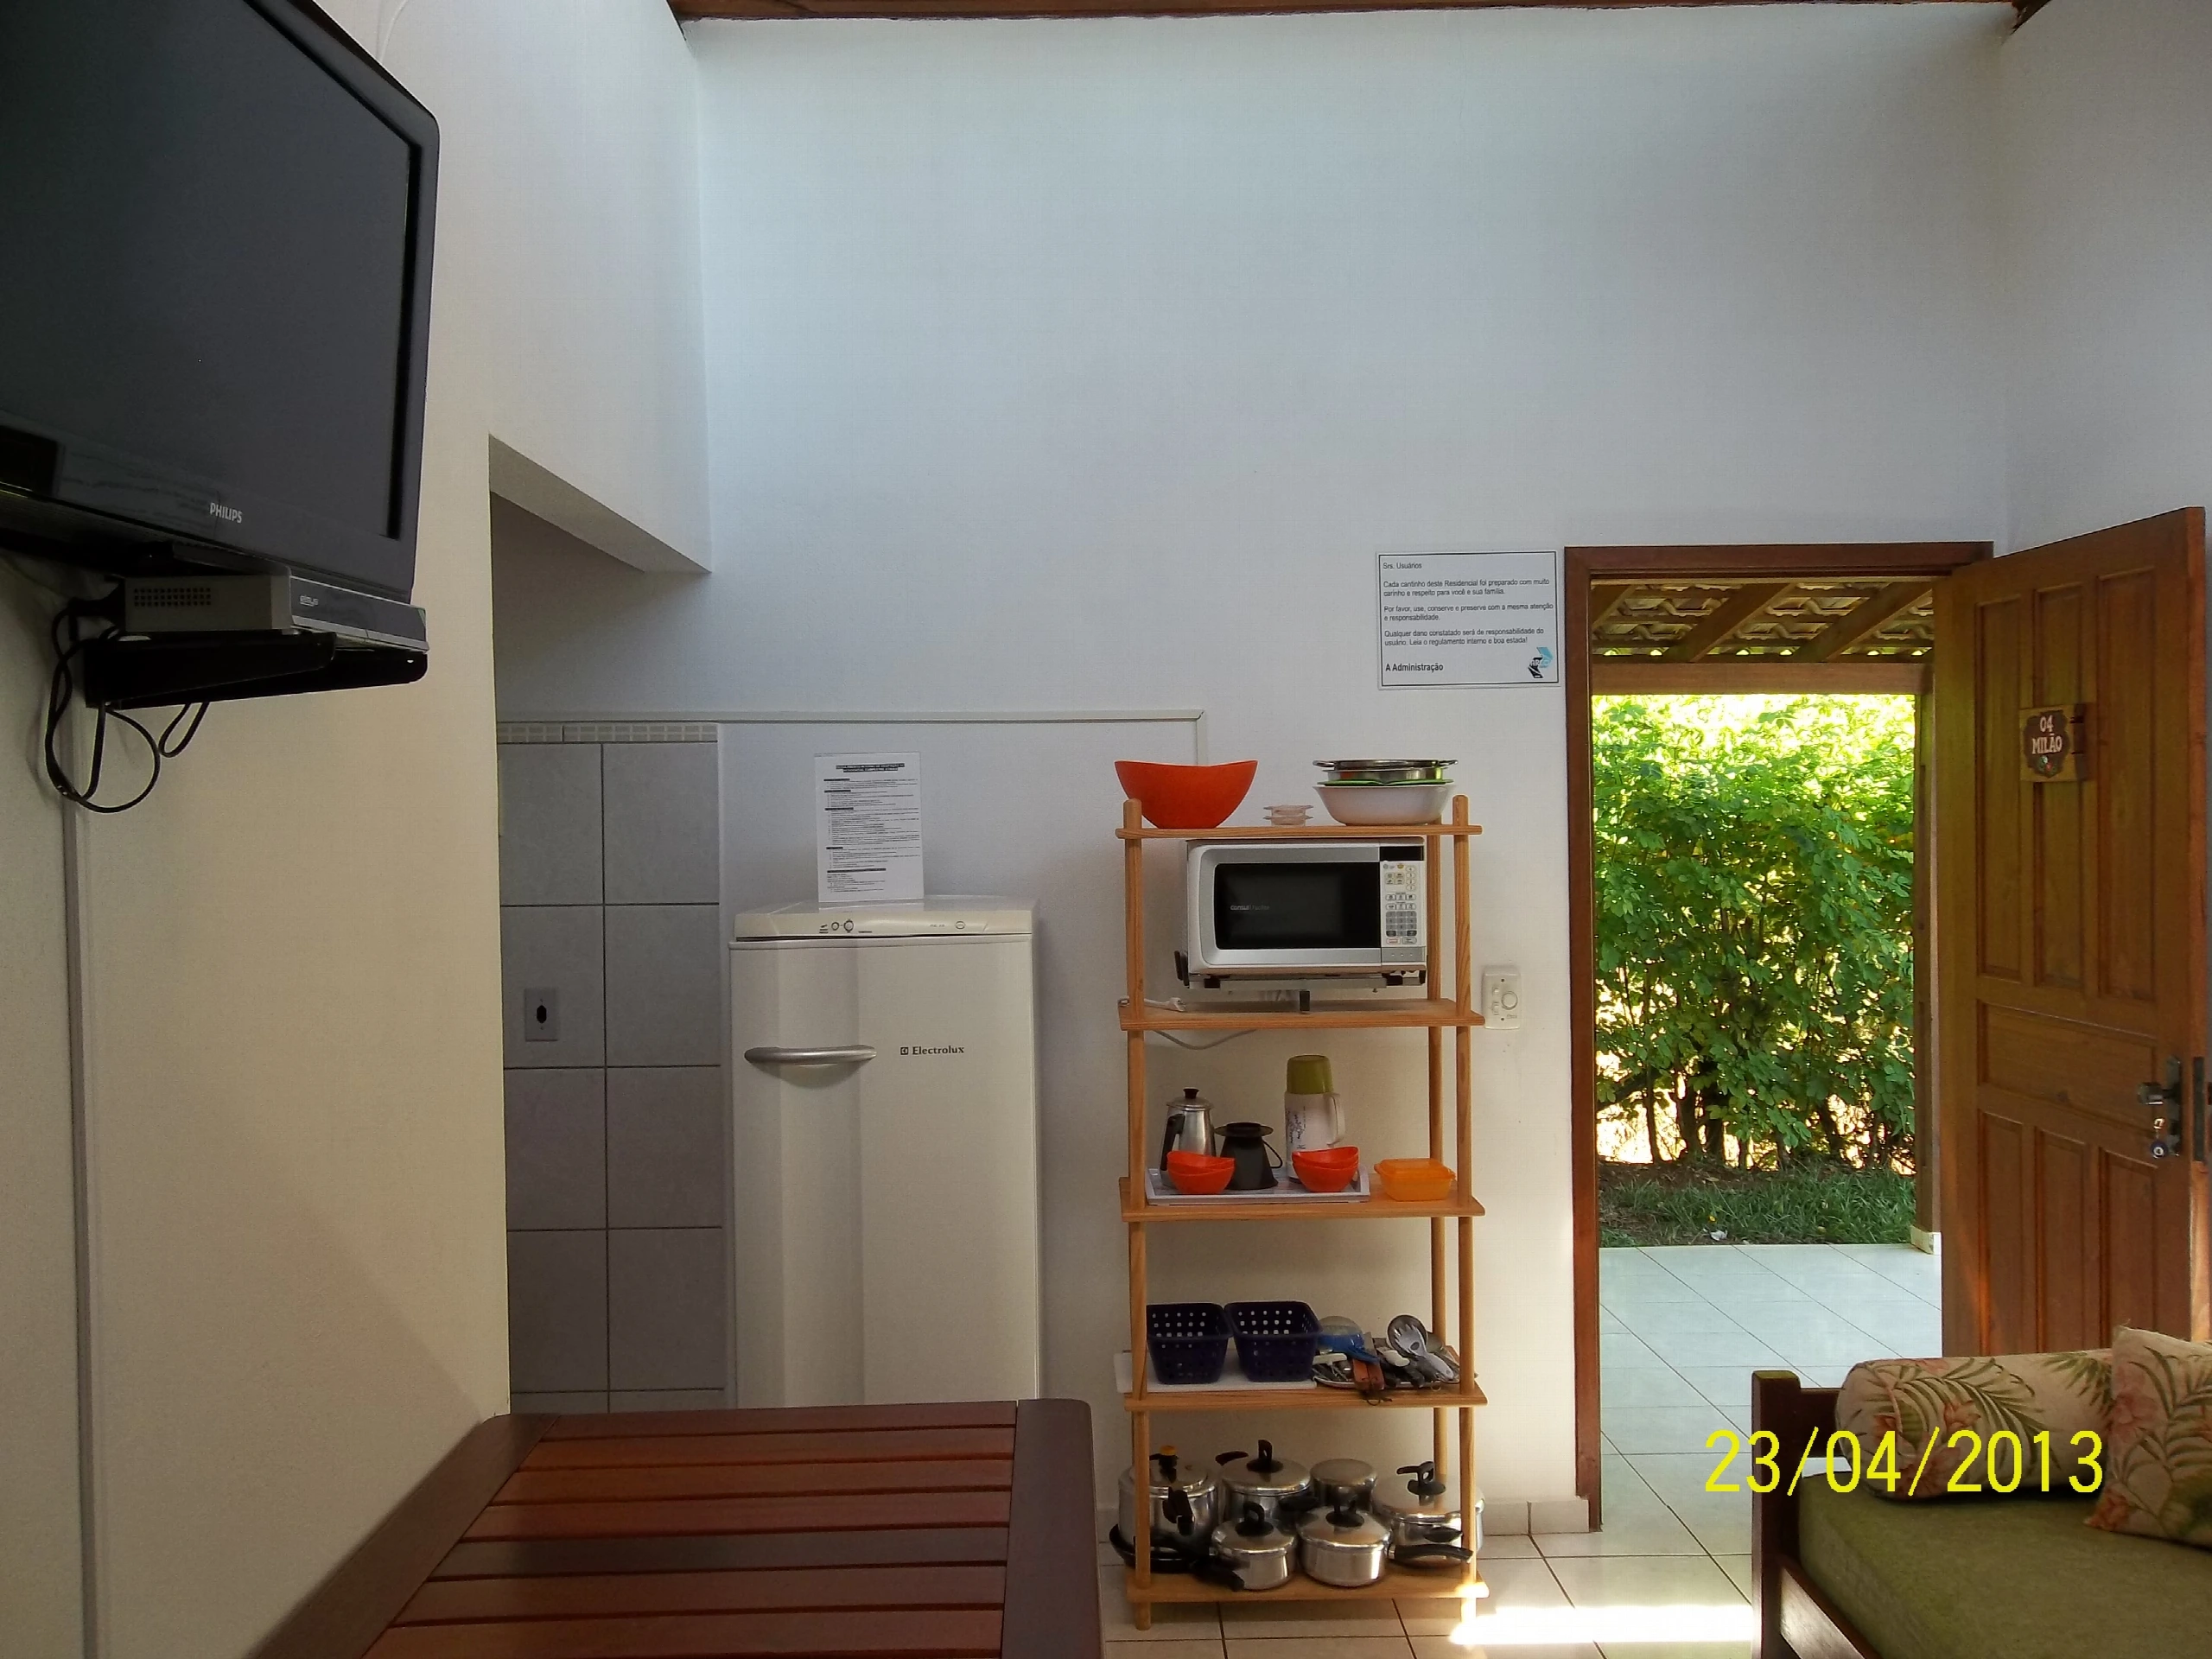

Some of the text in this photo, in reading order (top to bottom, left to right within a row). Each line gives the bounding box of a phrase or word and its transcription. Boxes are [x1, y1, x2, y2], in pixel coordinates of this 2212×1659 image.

[210, 502, 243, 523] PHILIPS
[1392, 662, 1444, 673] Administração
[2039, 715, 2054, 733] 04
[2031, 733, 2063, 754] MILÃO
[912, 1046, 964, 1055] Electrolux
